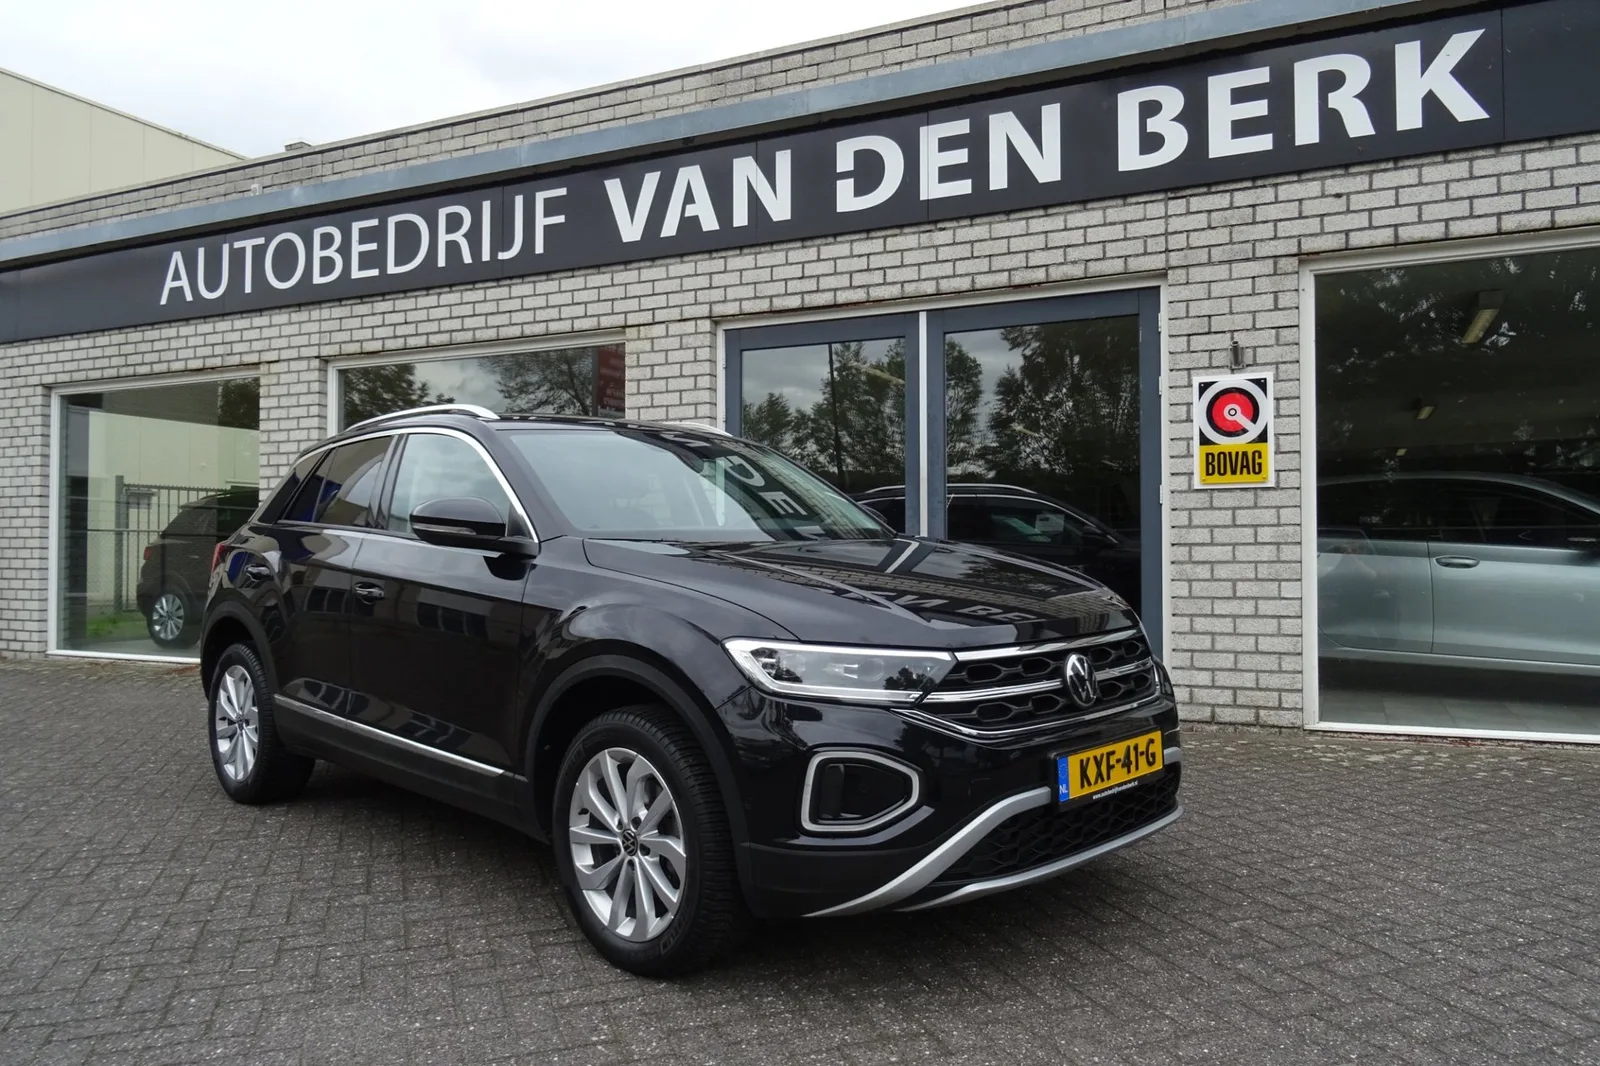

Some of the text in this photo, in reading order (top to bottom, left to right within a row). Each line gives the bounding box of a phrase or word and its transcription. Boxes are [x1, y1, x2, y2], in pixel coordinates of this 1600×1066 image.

[159, 28, 1490, 306] AUTOBEDRIJF VAN DEN BERK
[1205, 449, 1263, 477] BOVAG
[1080, 738, 1156, 789] KXF-41-G
[1059, 785, 1068, 795] NL
